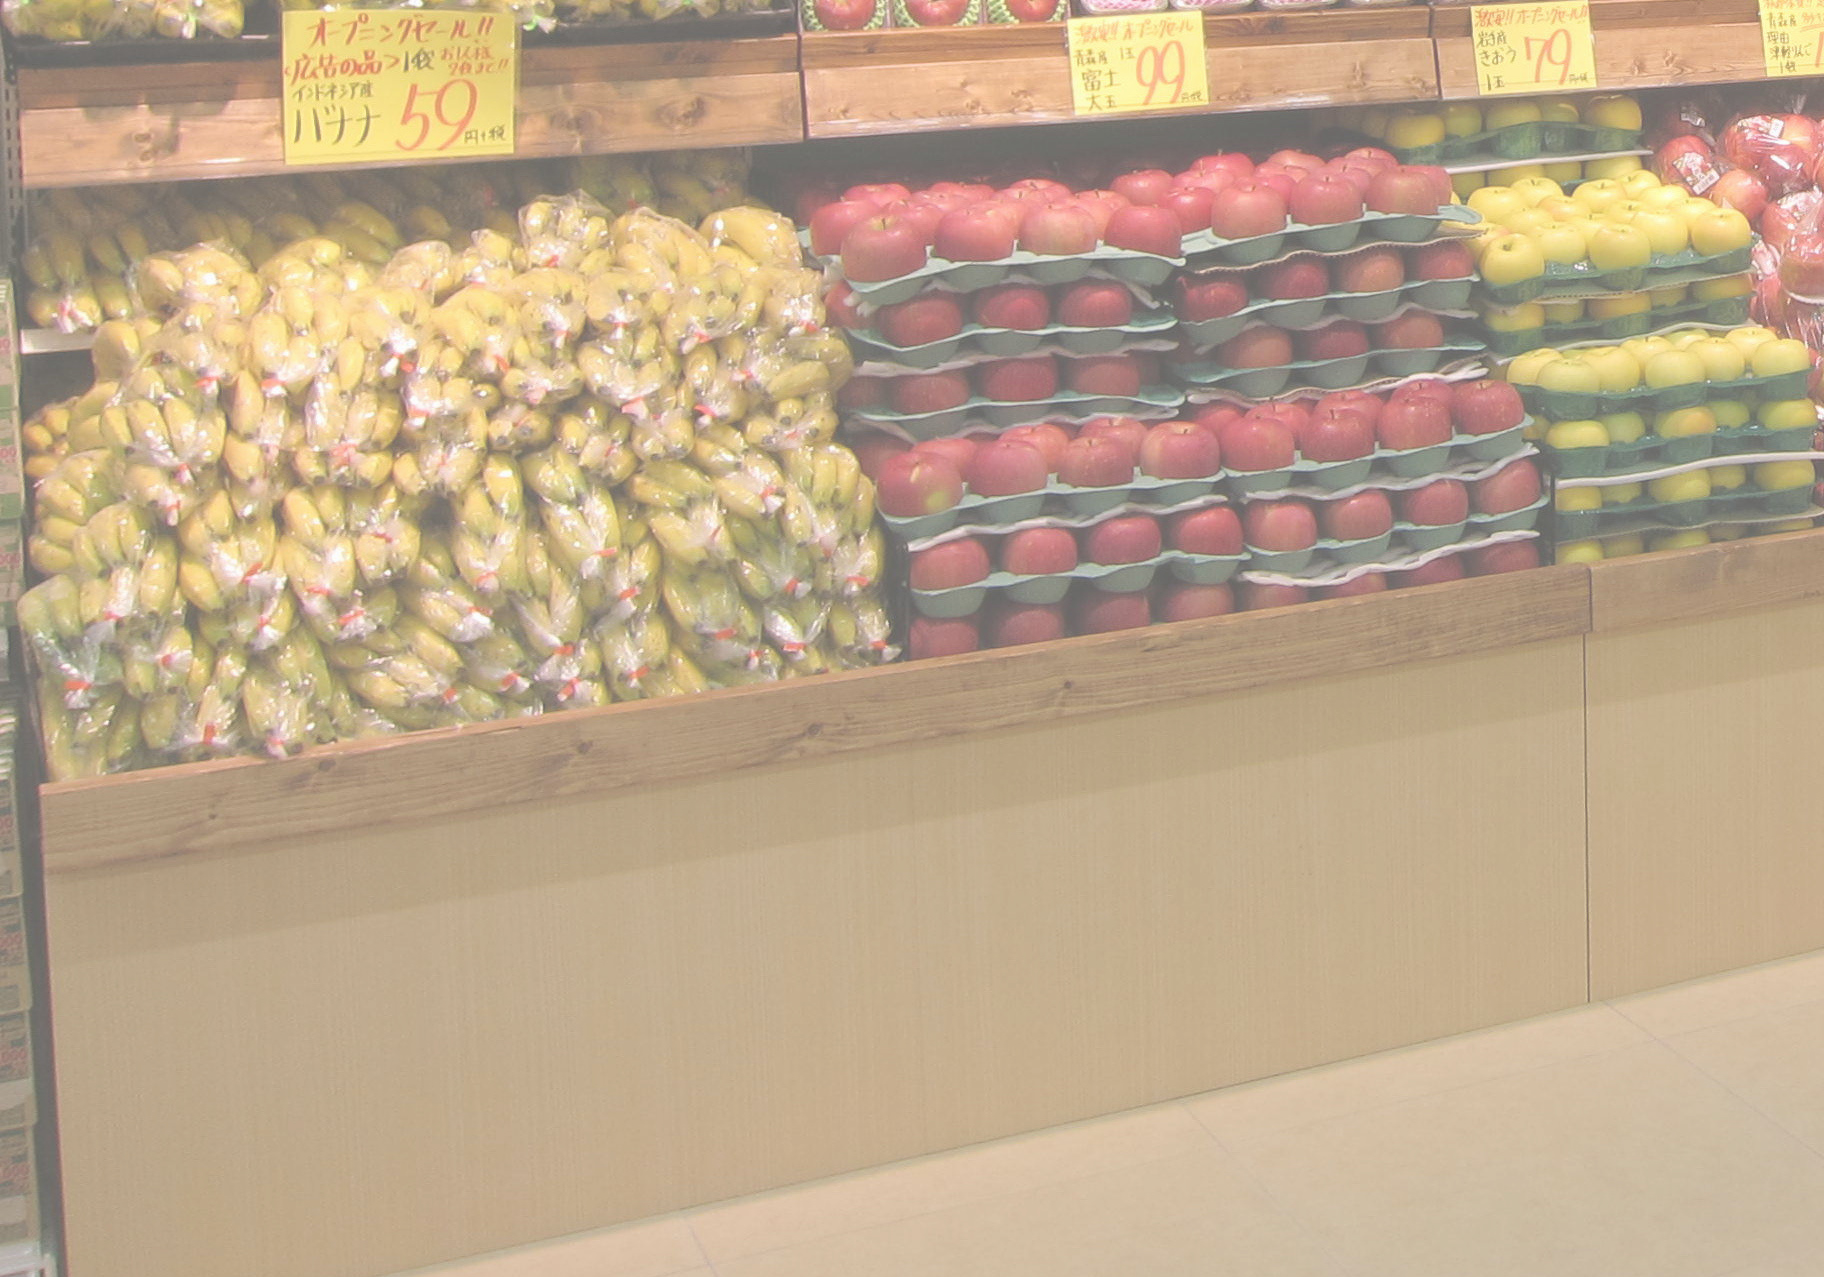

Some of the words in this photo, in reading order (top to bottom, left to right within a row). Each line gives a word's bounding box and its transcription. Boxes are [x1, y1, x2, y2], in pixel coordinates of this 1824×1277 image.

[307, 13, 495, 47] オープニングセール!!
[403, 48, 435, 72] 1袋
[1480, 47, 1516, 66] きおう
[1524, 29, 1572, 84] 79
[1082, 69, 1121, 91] 富士
[1136, 40, 1185, 105] 99
[1487, 74, 1504, 90] 1玉
[293, 81, 374, 102] インドネシア産
[1086, 94, 1117, 111] 大玉
[294, 105, 381, 146] バナナ
[395, 78, 477, 151] 59
